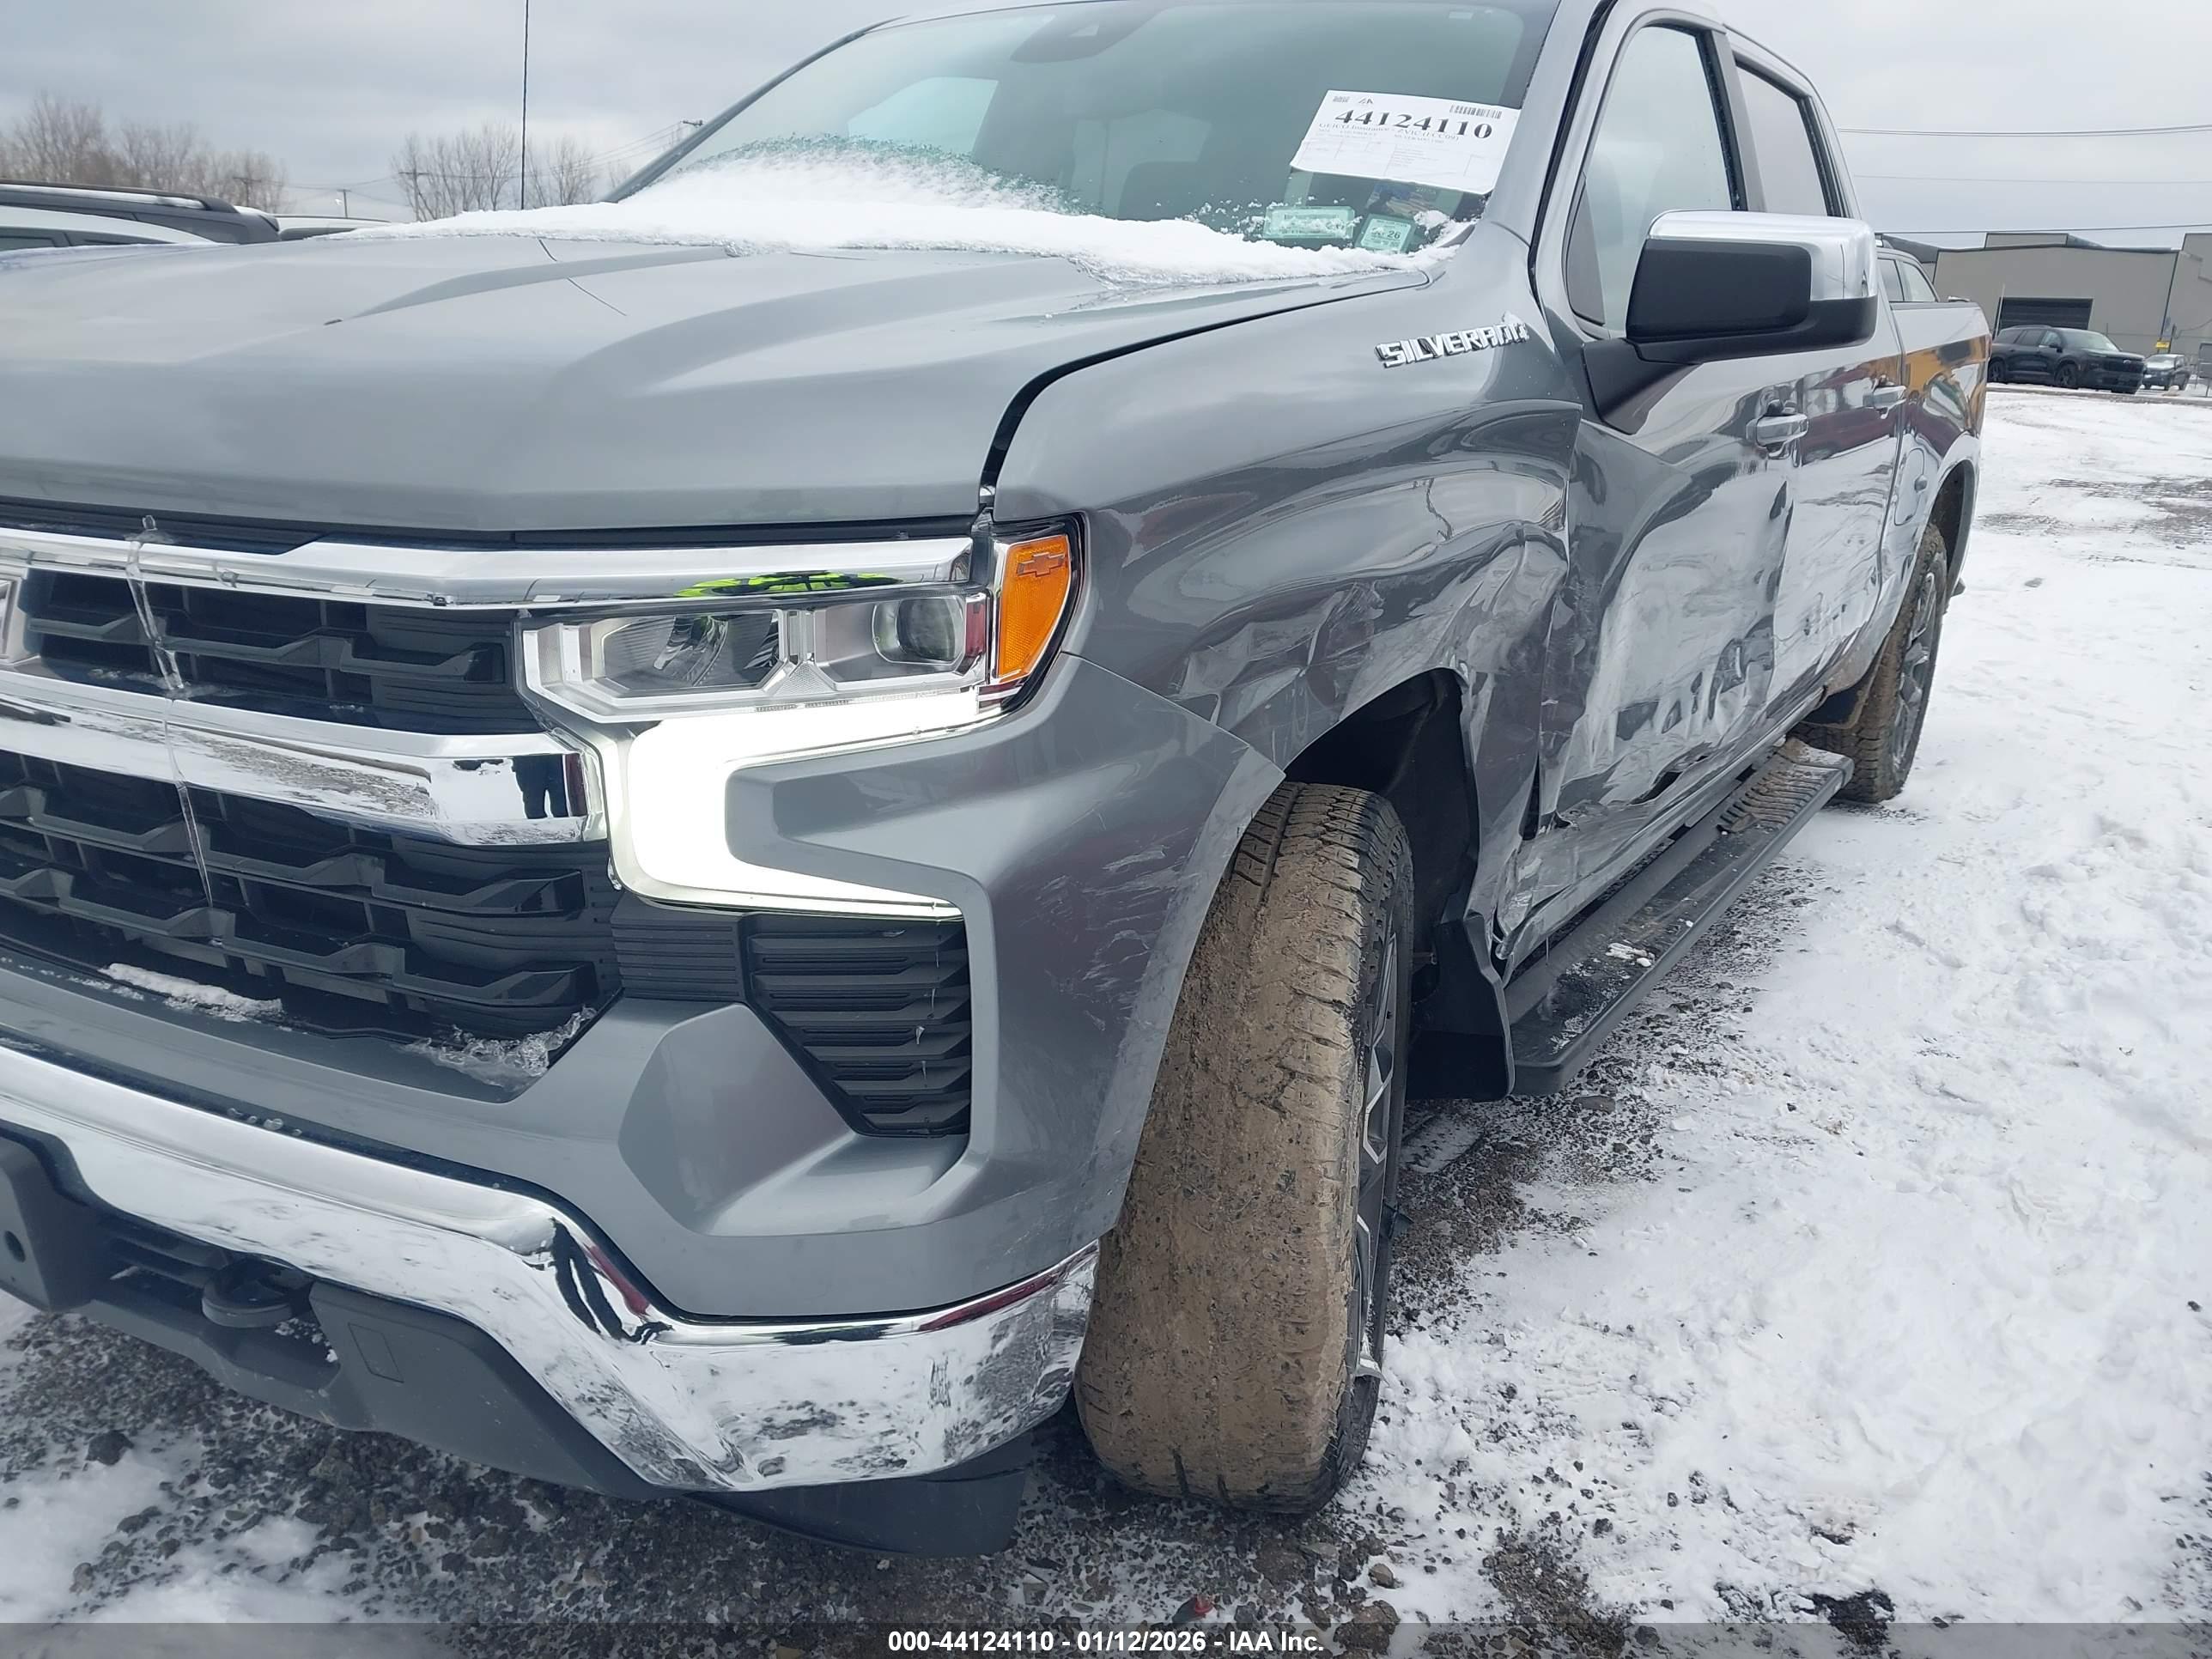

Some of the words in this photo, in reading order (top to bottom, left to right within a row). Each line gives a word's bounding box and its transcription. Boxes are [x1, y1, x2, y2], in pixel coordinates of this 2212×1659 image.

[1334, 109, 1493, 139] 44124110
[1387, 230, 1402, 240] 26
[1376, 323, 1529, 368] SILVERADO
